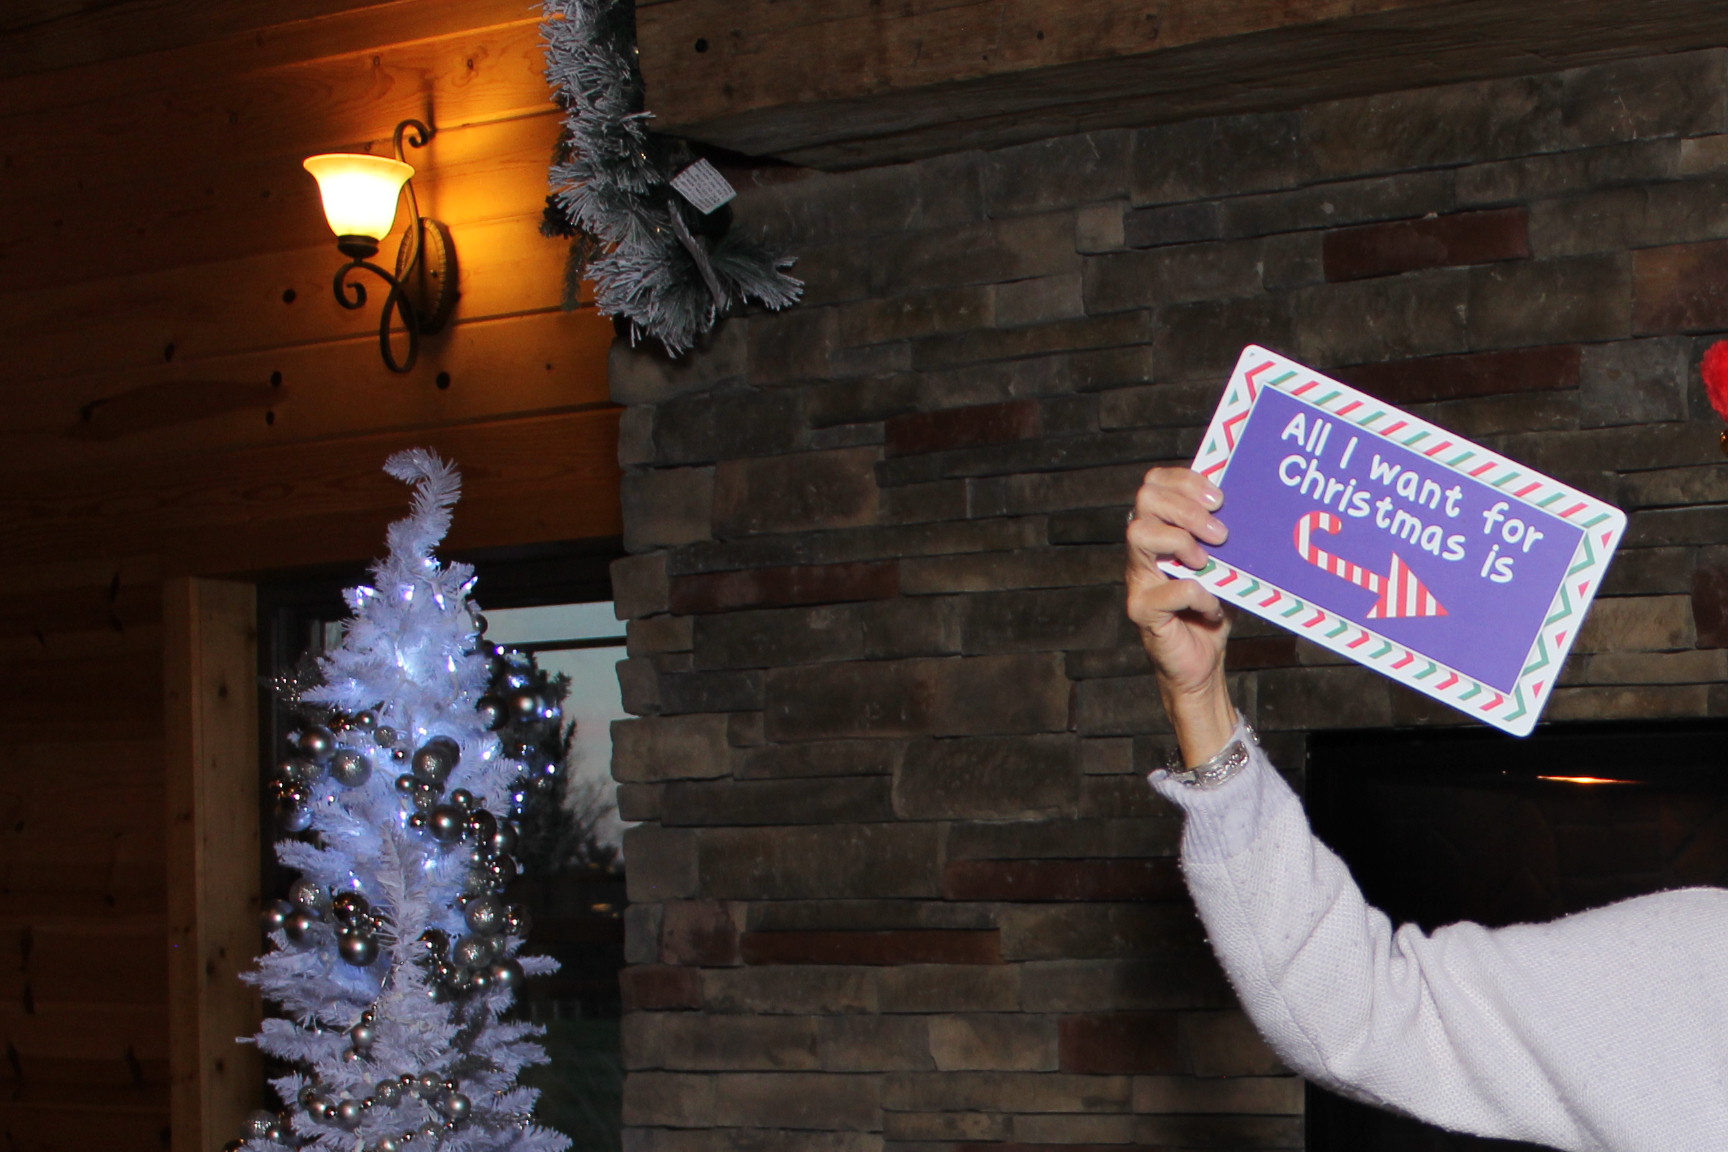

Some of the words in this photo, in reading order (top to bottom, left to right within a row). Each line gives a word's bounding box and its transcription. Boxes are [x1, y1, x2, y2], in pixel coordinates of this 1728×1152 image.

[1278, 454, 1467, 562] Christmas
[1480, 543, 1515, 584] is
[1280, 412, 1333, 457] All
[1339, 436, 1359, 470] I
[1369, 453, 1464, 518] want
[1482, 501, 1545, 554] for
